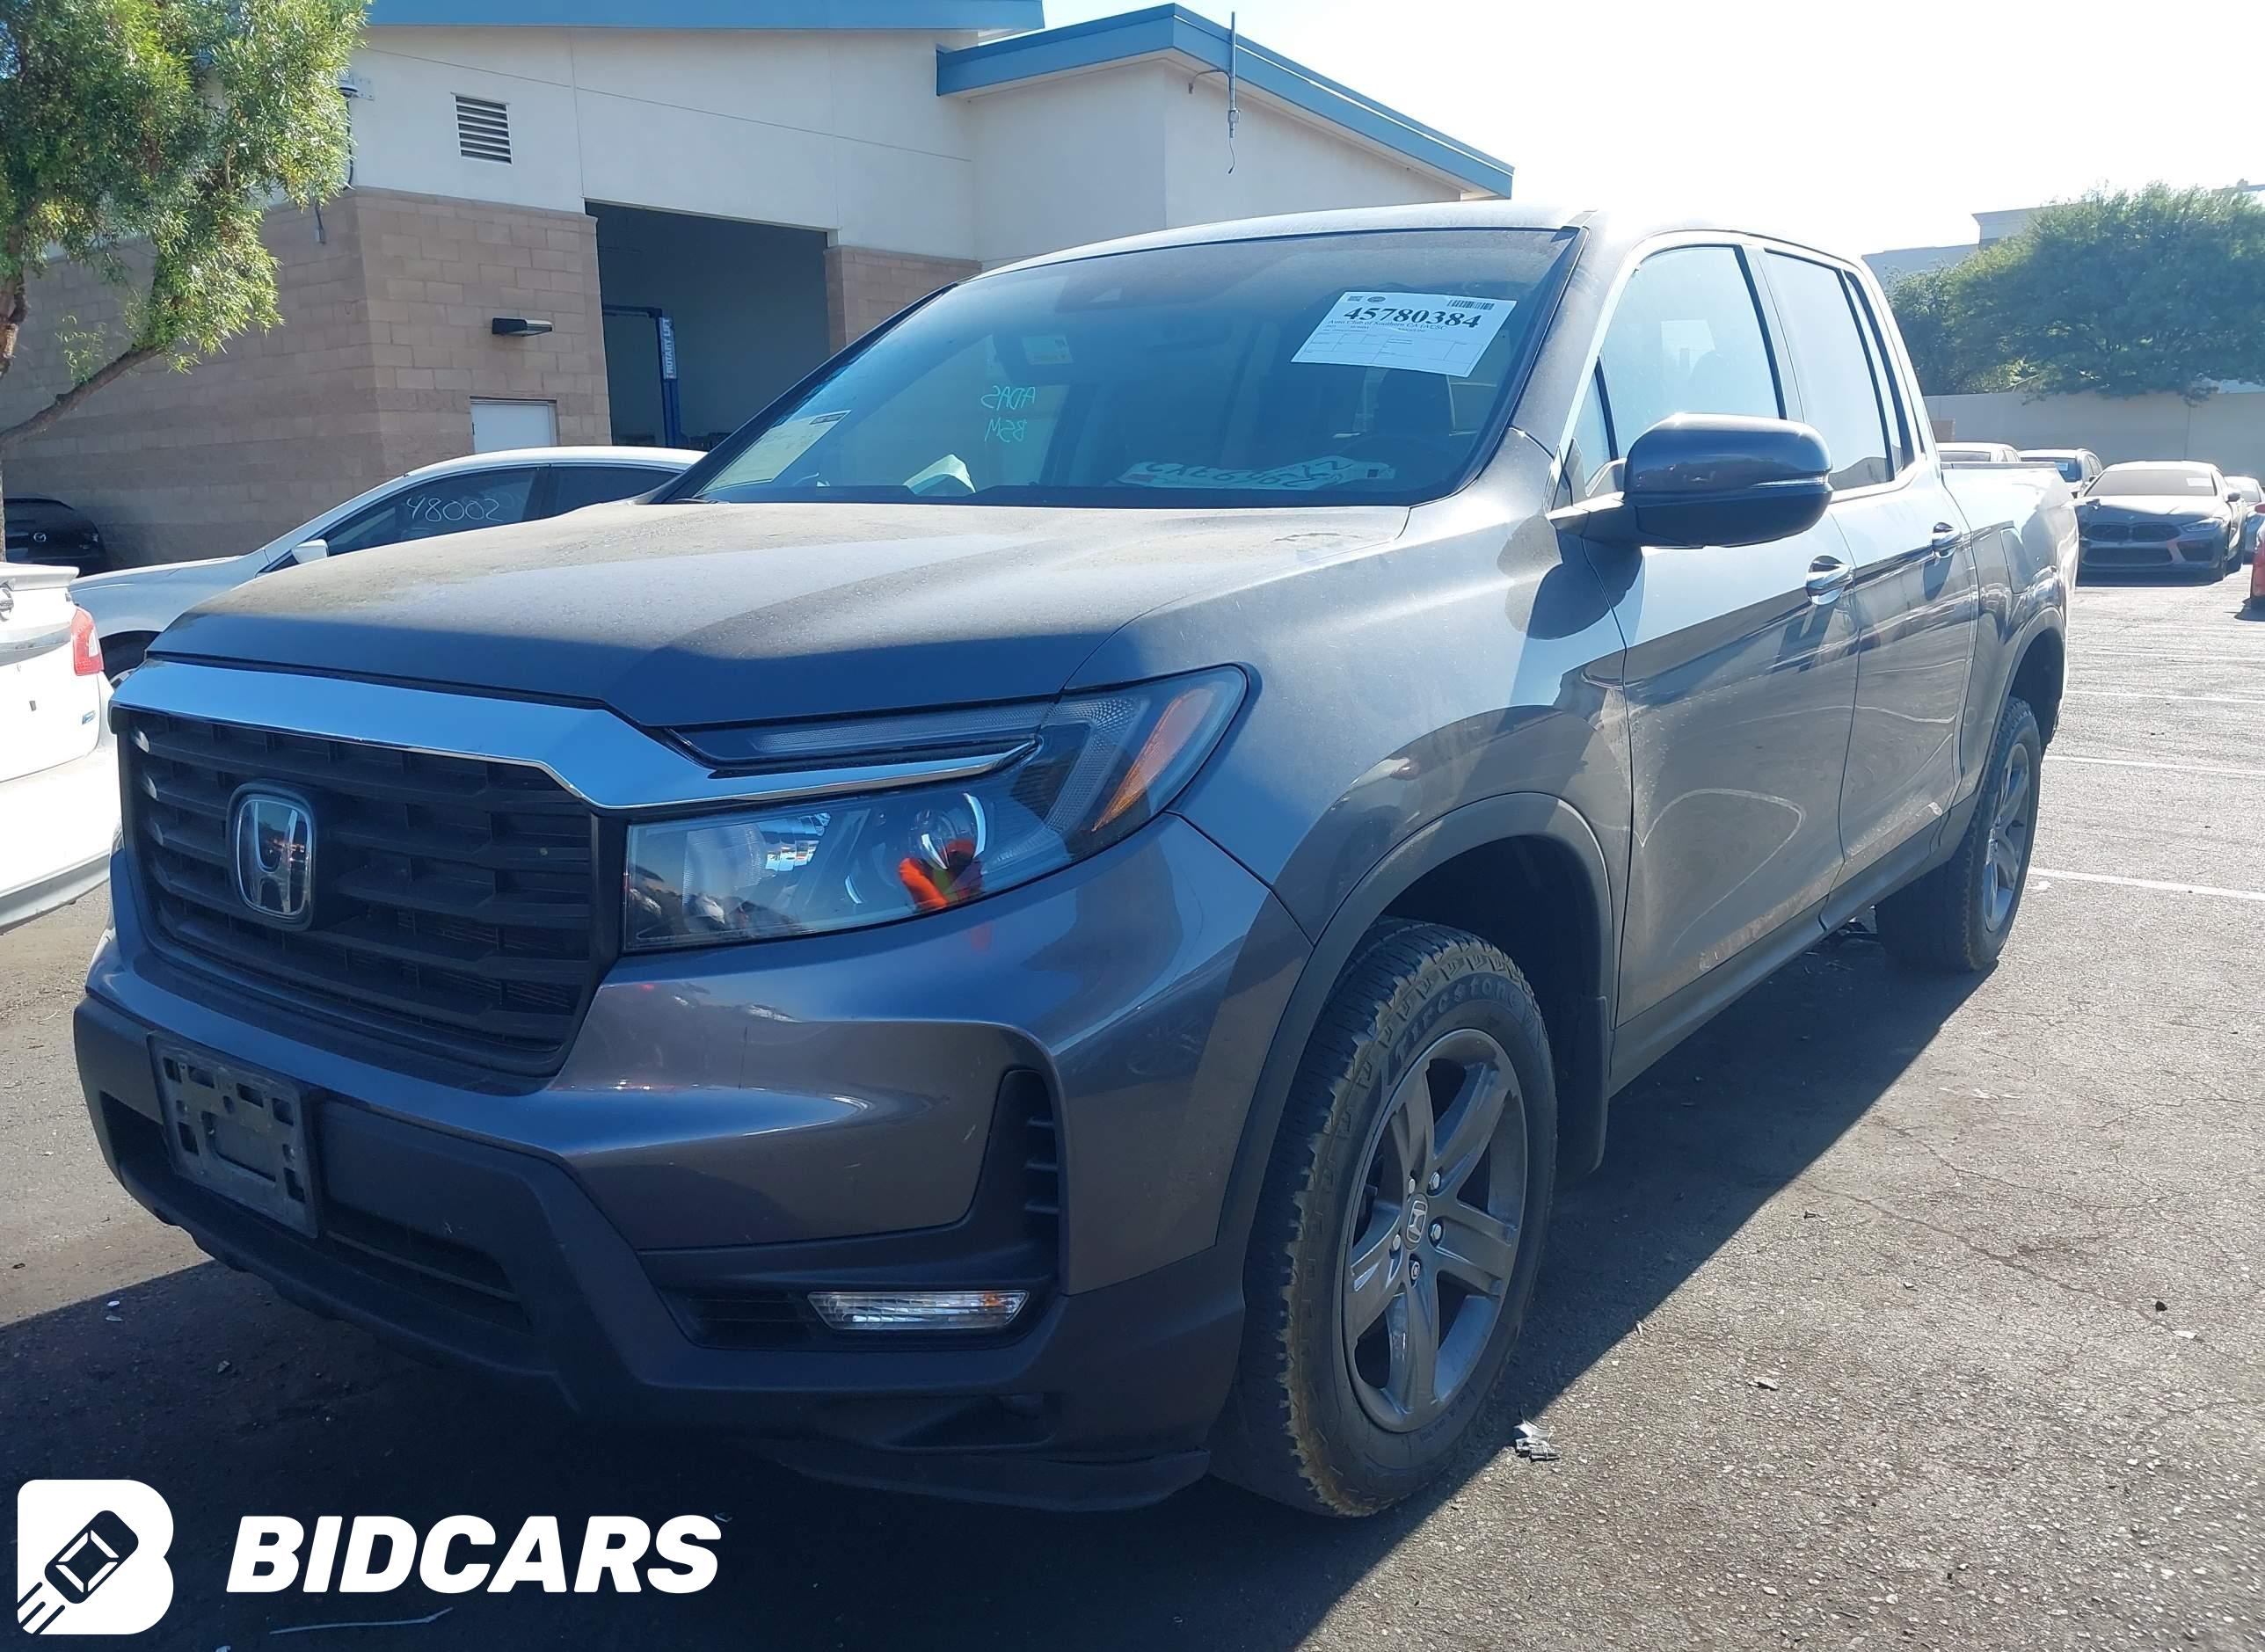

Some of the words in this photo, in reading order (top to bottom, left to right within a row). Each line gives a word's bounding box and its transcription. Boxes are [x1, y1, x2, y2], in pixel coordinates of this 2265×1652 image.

[662, 318, 671, 337] LIFT
[1344, 307, 1482, 329] 45780384
[664, 338, 674, 374] ROTARY
[406, 498, 504, 522] 48002
[1393, 977, 1524, 1063] Firestone
